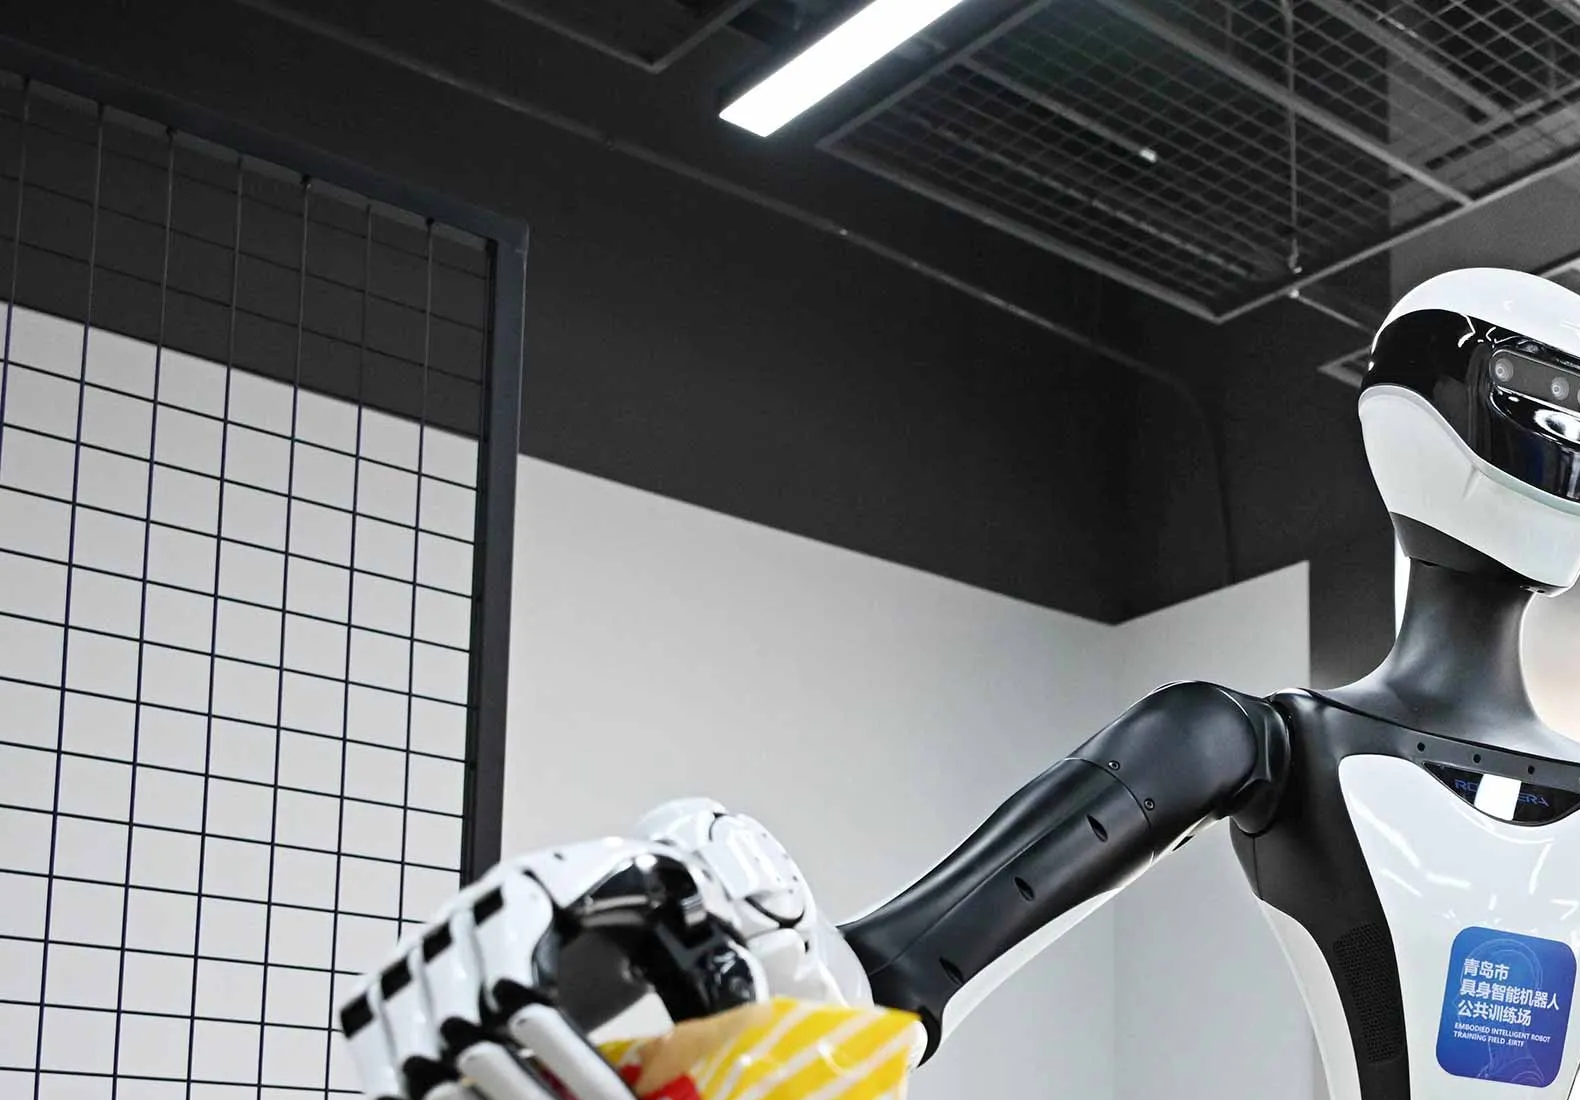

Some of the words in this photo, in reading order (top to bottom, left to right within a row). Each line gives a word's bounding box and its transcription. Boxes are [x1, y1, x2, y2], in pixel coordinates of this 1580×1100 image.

[1454, 779, 1550, 808] ROERA
[1463, 958, 1510, 981] 青岛市
[1459, 979, 1560, 1011] 具身智能机器人
[1457, 999, 1532, 1027] 公共训练场
[1453, 1030, 1487, 1042] TRAINING
[1487, 1035, 1505, 1045] FIELD
[1454, 1022, 1490, 1034] EMBODIED
[1491, 1027, 1530, 1040] INTELLIGENT
[1531, 1034, 1551, 1044] ROBOT
